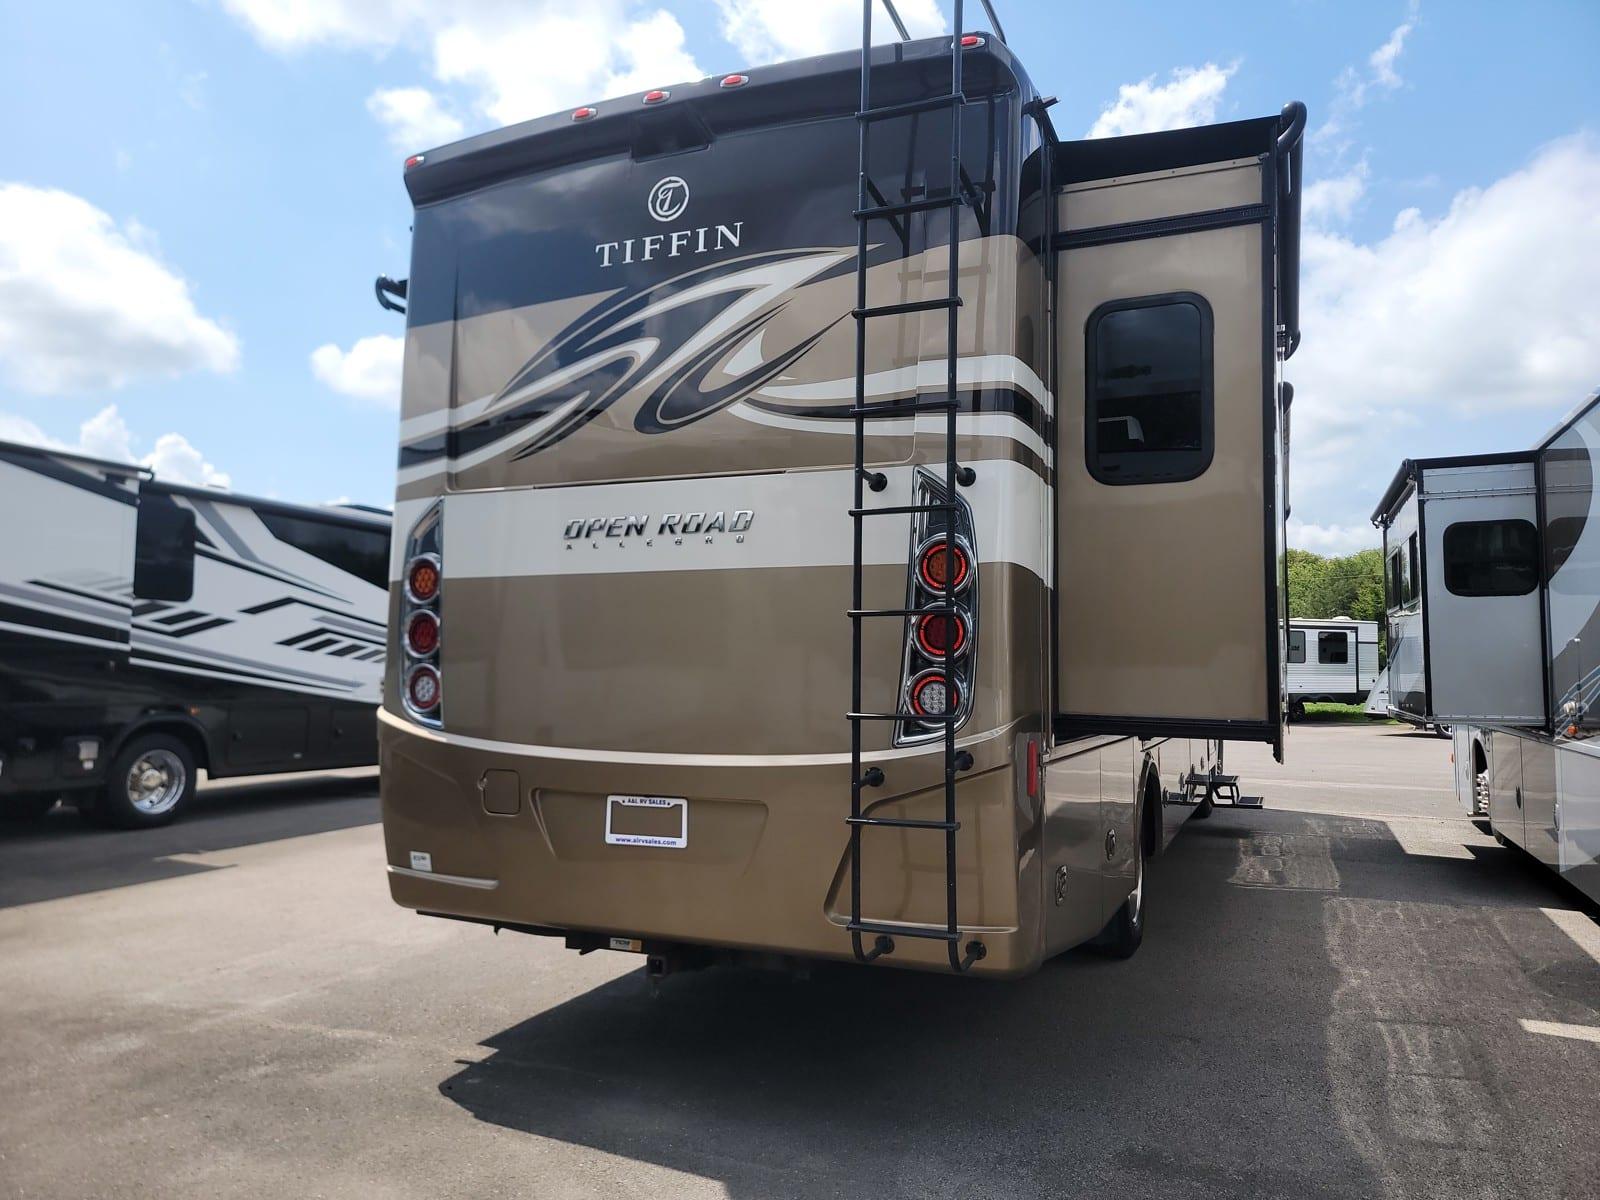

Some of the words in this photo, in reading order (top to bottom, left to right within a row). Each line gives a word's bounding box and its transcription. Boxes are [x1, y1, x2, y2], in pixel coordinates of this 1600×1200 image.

[595, 221, 744, 268] TIFFIN
[563, 514, 650, 540] OPEN
[657, 510, 754, 535] ROAD
[648, 798, 666, 806] SALES
